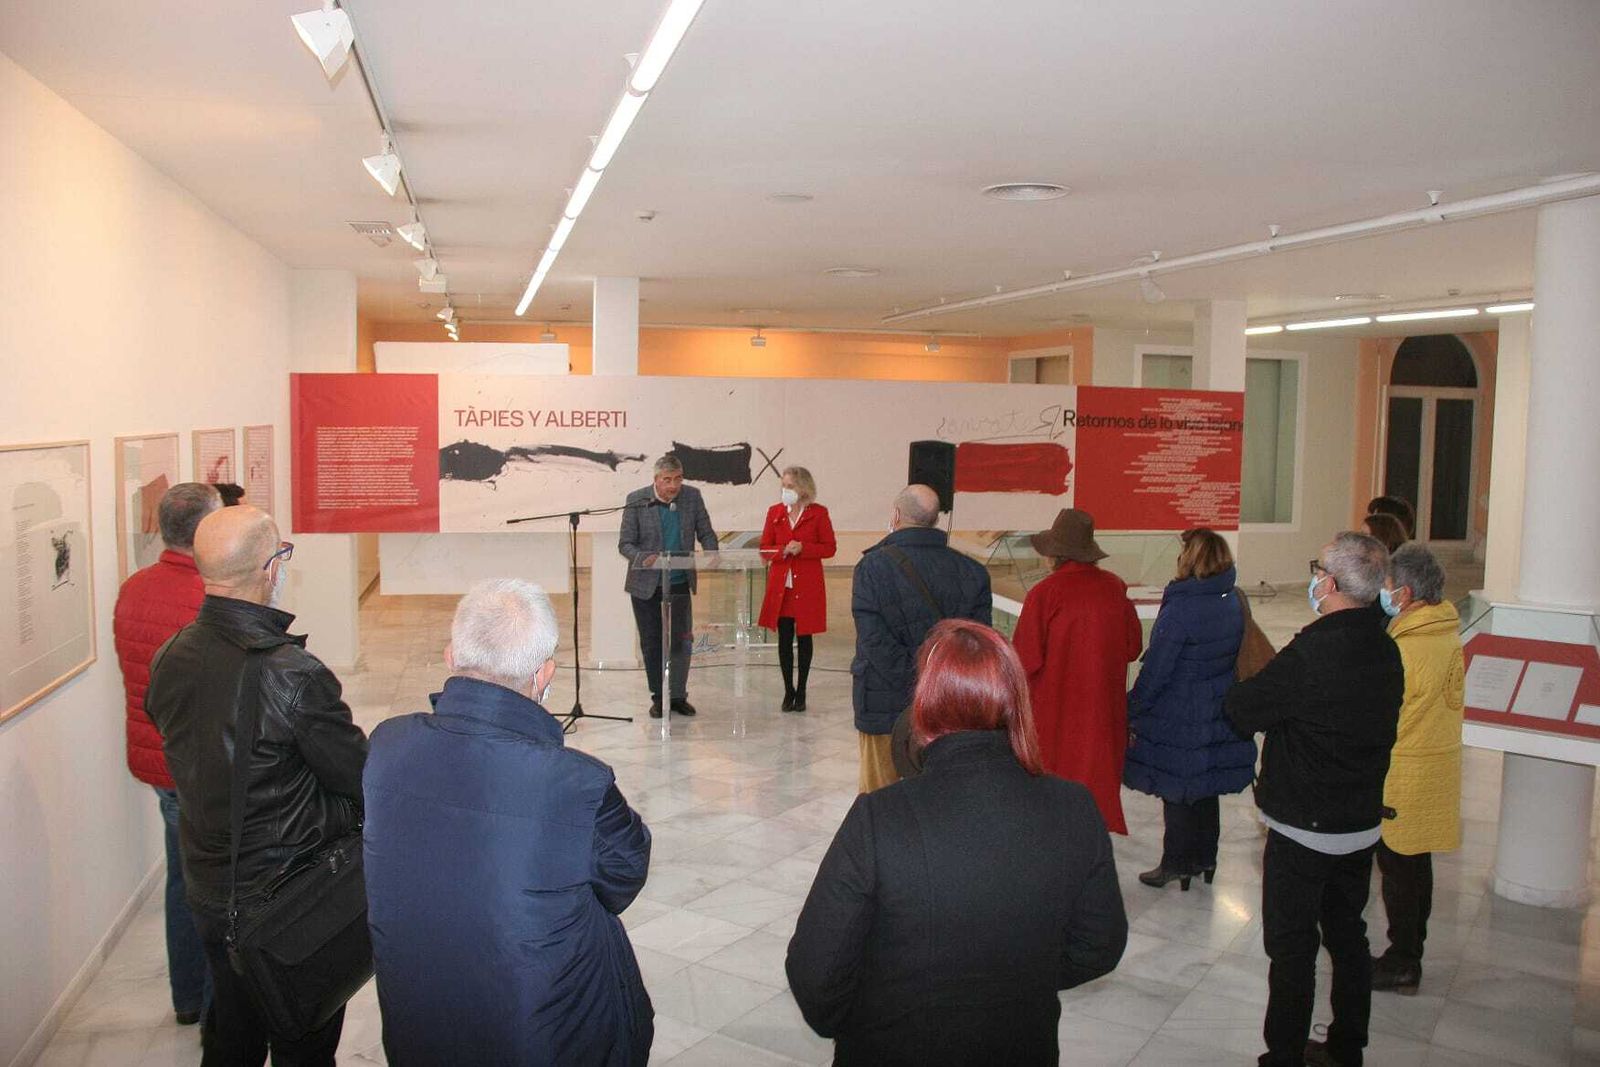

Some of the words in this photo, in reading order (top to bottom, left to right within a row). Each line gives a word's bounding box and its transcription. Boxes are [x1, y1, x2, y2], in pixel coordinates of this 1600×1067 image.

[454, 405, 524, 427] TÀPIES
[528, 410, 541, 427] Y
[545, 410, 627, 428] ALBERTI
[1063, 409, 1135, 429] Retornos
[1138, 415, 1157, 430] de
[1160, 416, 1173, 430] lo
